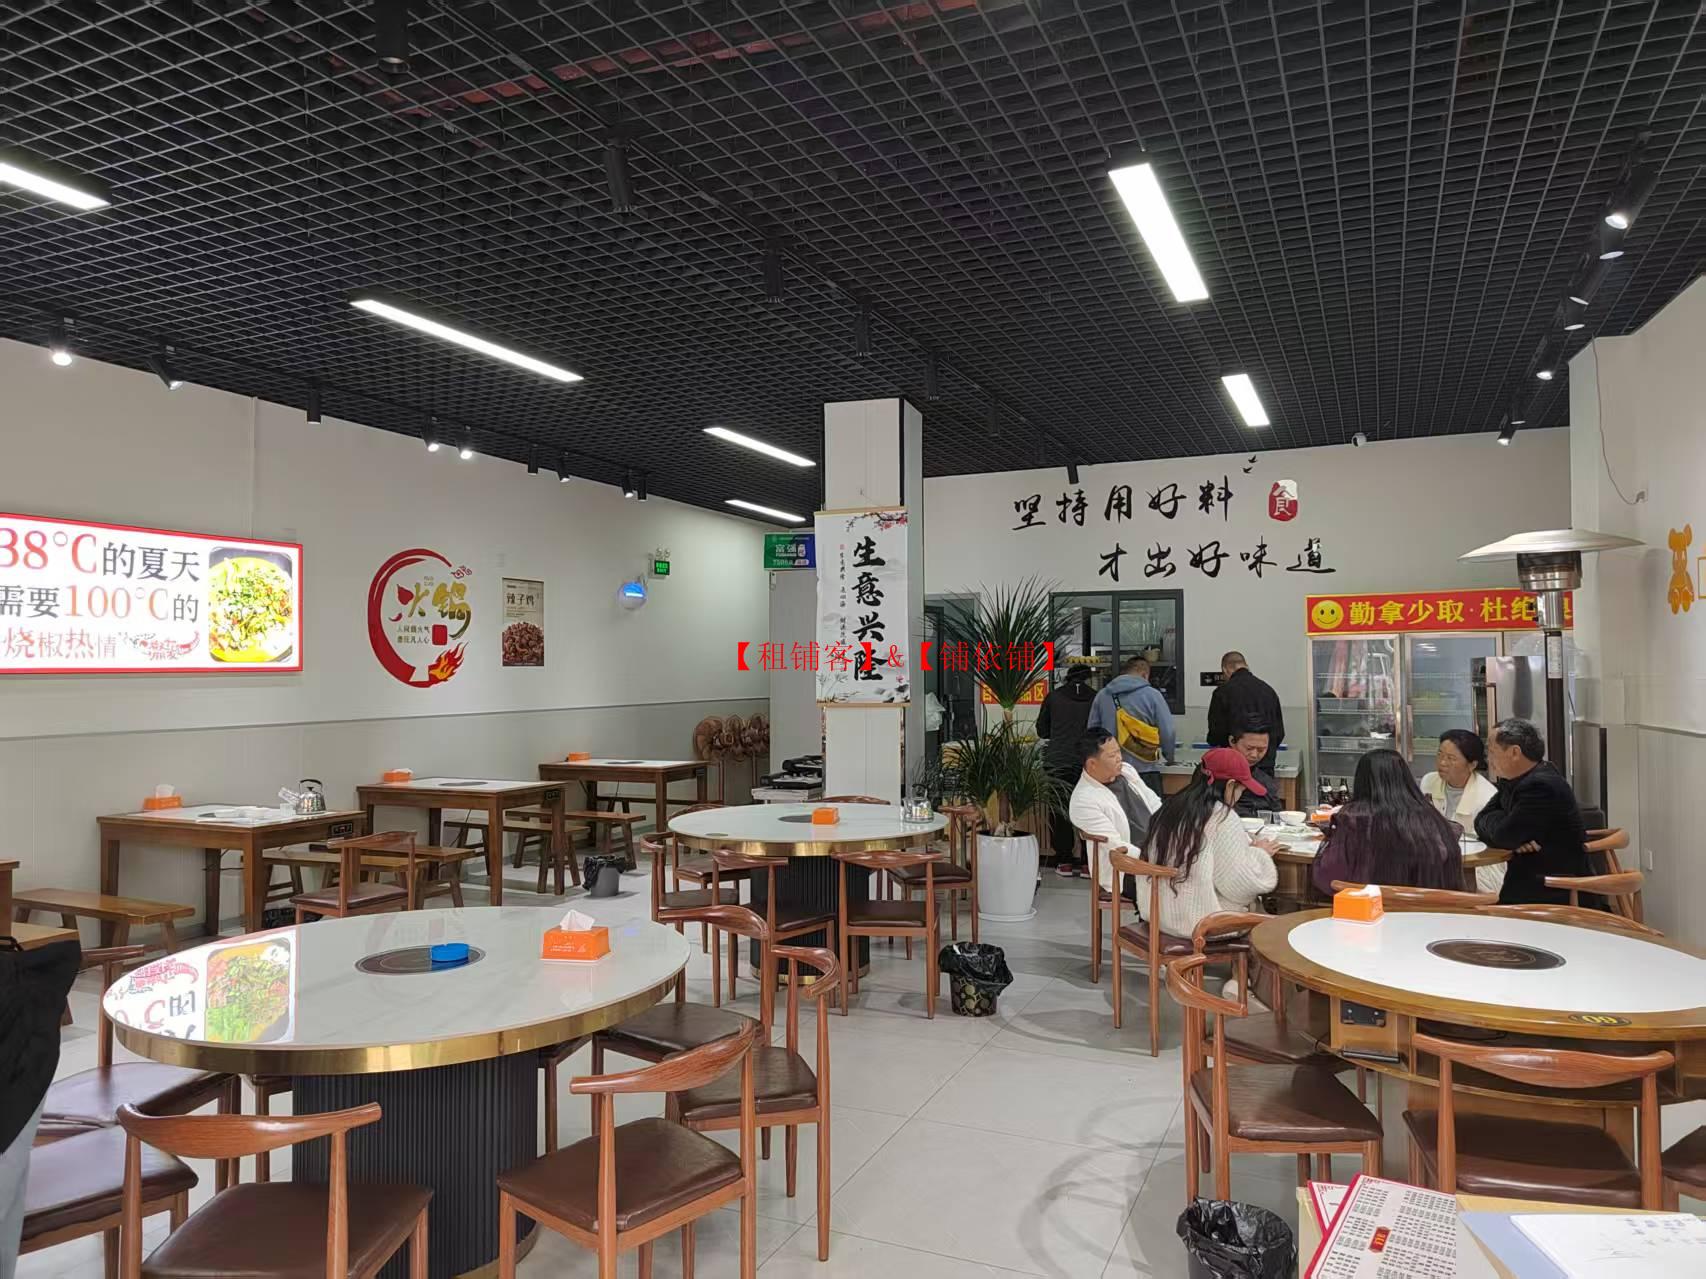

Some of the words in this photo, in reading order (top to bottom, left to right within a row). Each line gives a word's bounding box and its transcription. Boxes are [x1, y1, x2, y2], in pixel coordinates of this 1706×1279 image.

[1012, 475, 1234, 530] 坚持用好料
[1098, 535, 1336, 582] 才出好味道
[851, 536, 888, 681] 生意兴隆
[1349, 596, 1572, 626] 勤拿少取·杜绝
